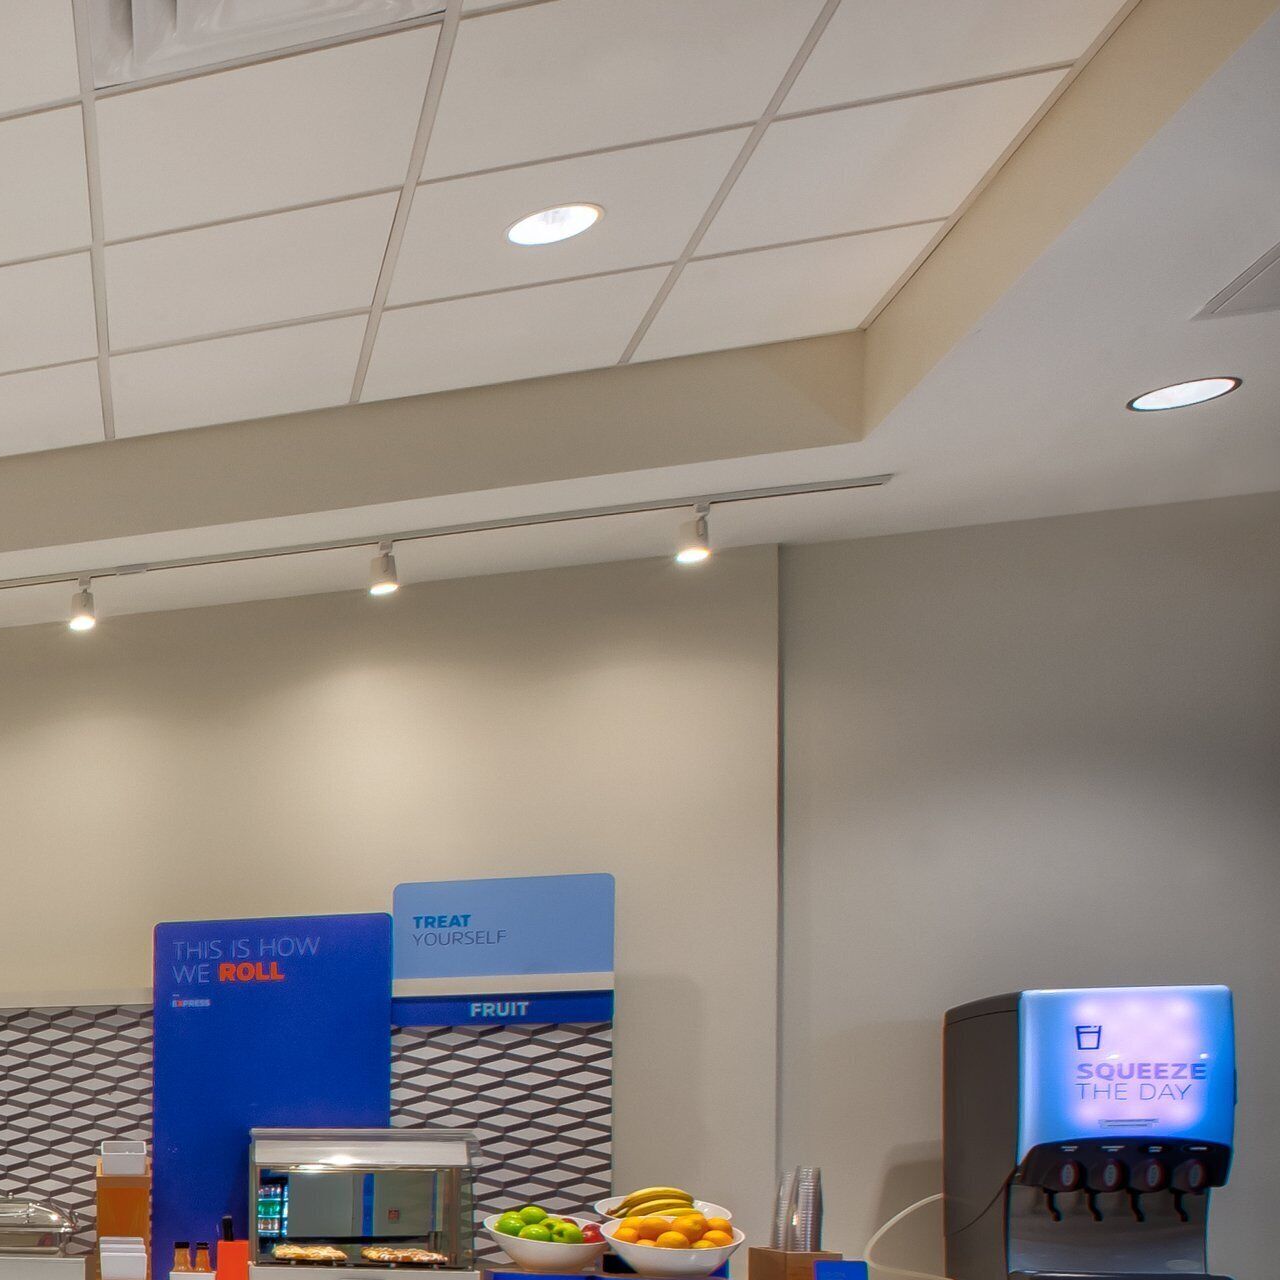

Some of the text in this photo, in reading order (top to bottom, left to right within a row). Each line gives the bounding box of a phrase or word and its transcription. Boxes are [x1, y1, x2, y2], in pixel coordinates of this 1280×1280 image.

[413, 914, 471, 929] TREAT
[413, 930, 507, 946] YOURSELF
[172, 937, 321, 960] THIS IS HOW
[172, 962, 285, 984] WE ROLL
[470, 1001, 530, 1017] FRUIT
[1076, 1062, 1207, 1081] SQUEEZE
[1075, 1083, 1192, 1100] THE DAY
